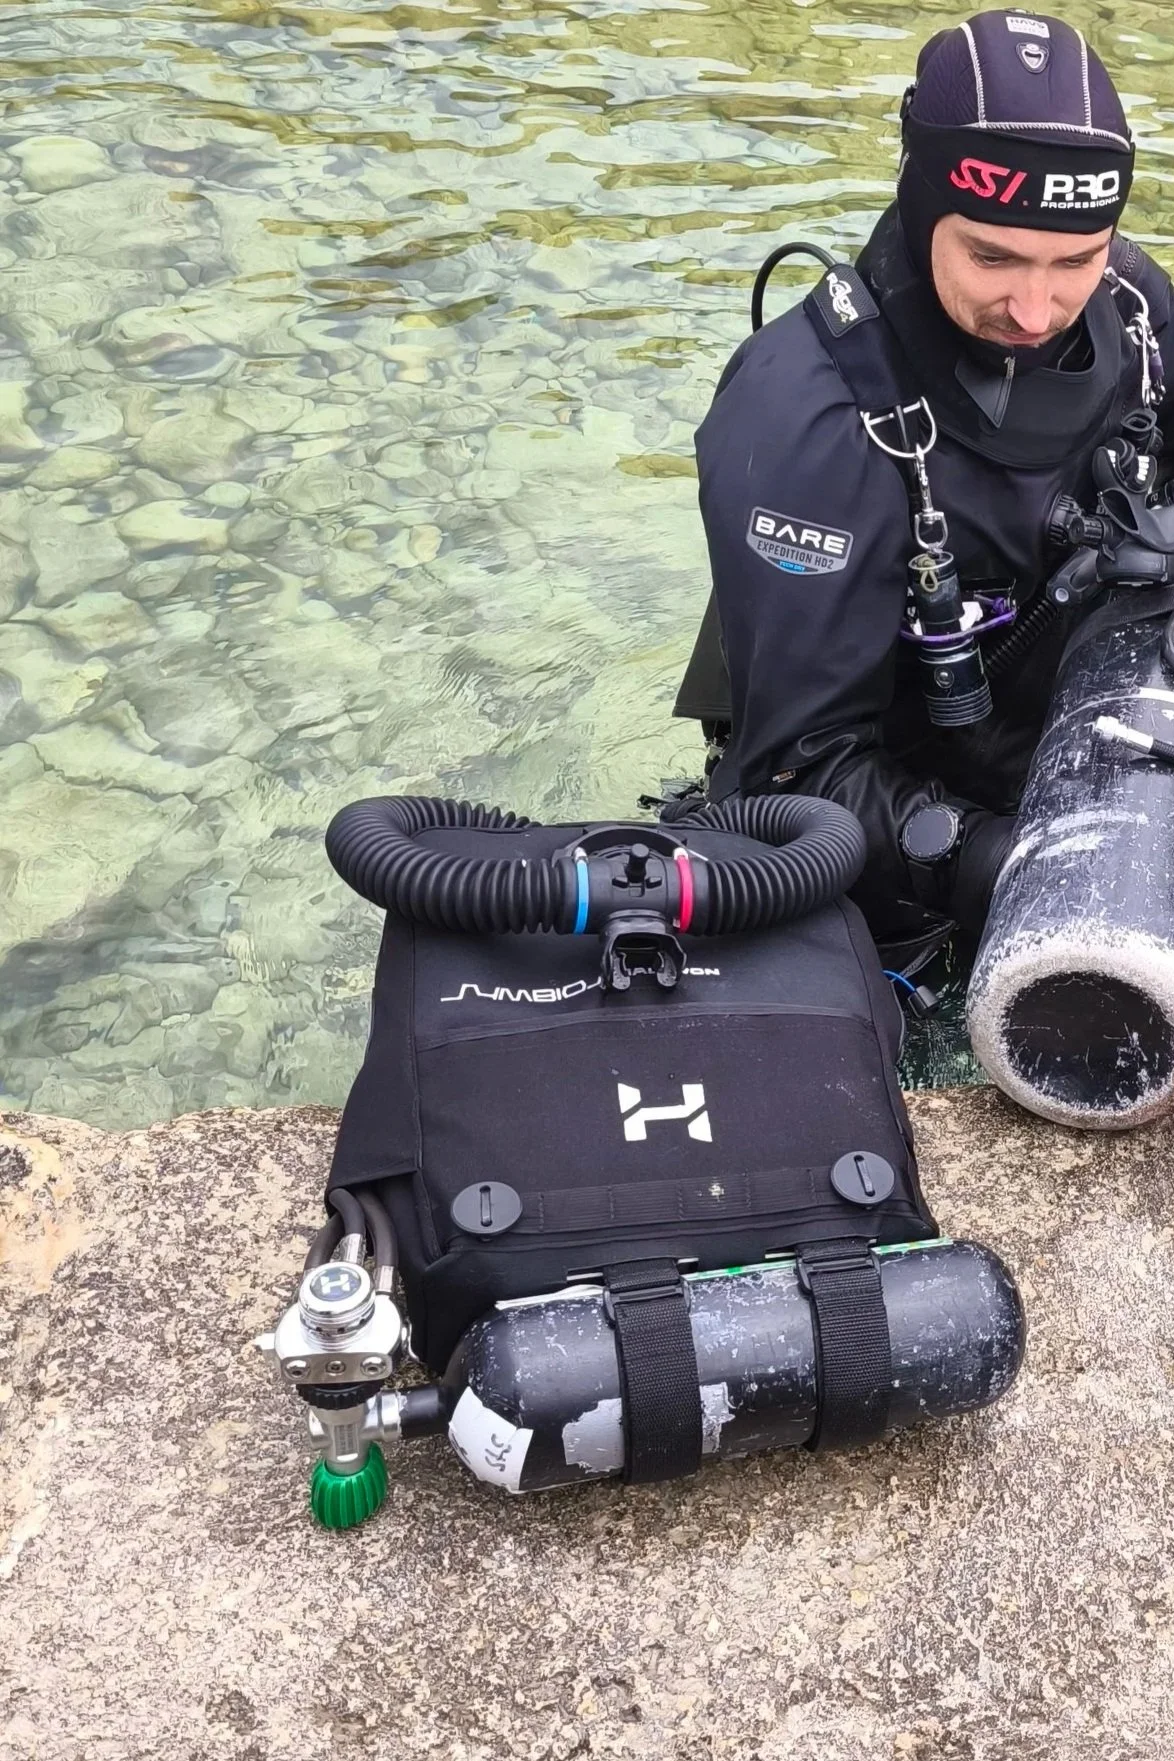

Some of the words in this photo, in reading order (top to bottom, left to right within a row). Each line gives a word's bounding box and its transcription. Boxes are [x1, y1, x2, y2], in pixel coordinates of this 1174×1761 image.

[950, 157, 1027, 203] SSI
[1043, 169, 1120, 201] PRO
[1040, 195, 1120, 209] PROFESSIONAL
[755, 515, 846, 555] BARE
[757, 540, 813, 564] EXPEDITION
[814, 555, 834, 569] HD2
